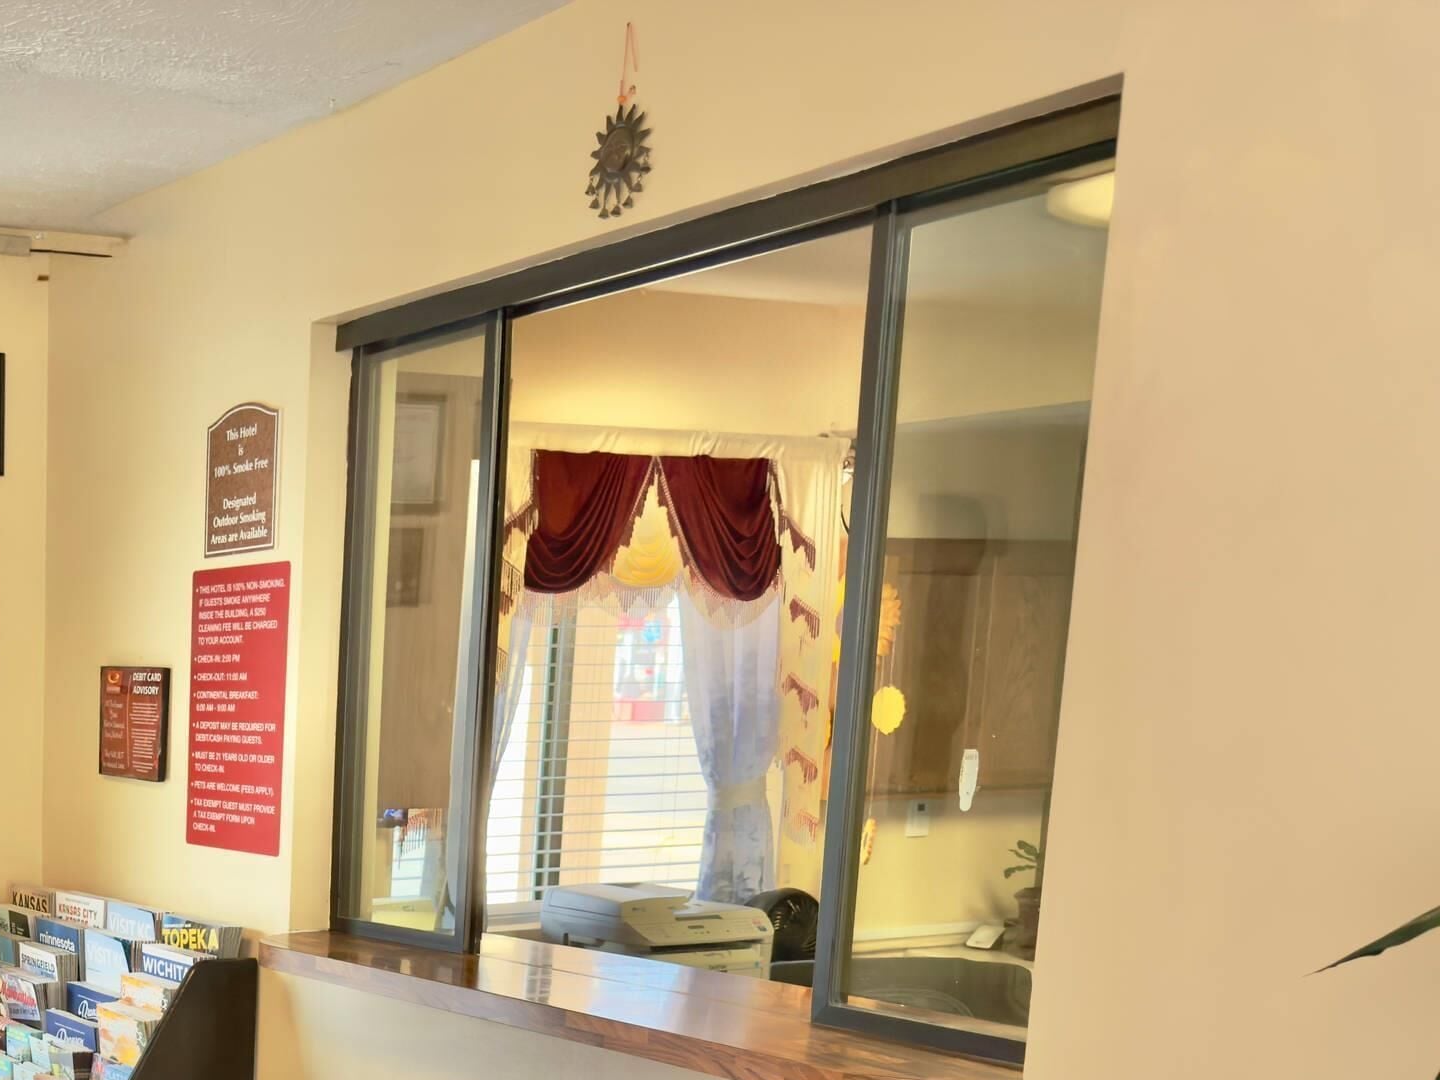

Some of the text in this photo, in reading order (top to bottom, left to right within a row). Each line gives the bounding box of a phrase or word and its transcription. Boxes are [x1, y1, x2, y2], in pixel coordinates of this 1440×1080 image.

[226, 423, 258, 441] This Hotel
[238, 444, 244, 456] is
[214, 457, 269, 479] 100% Smoke Free
[223, 492, 256, 511] Designated
[213, 509, 266, 529] Outdoor Smoking
[211, 525, 268, 545] Areas are Available
[200, 585, 210, 594] THIS
[210, 584, 226, 593] HOTEL
[223, 595, 241, 606] SMOKE
[223, 622, 232, 632] FEE
[233, 621, 244, 631] WILL
[245, 621, 252, 630] BE
[253, 620, 278, 630] CHARGED
[198, 637, 204, 645] TO
[205, 636, 219, 645] YOUR
[232, 654, 240, 662] PM
[132, 672, 162, 682] DEBIT CARD
[132, 685, 159, 696] ADVISORY
[232, 723, 239, 731] BE
[265, 723, 276, 732] FOR
[222, 753, 237, 762] YEARS
[238, 754, 249, 762] OLD
[250, 754, 257, 763] OR
[258, 755, 275, 764] OLDER
[12, 891, 48, 914] KANSAS
[58, 903, 98, 921] KANSAS CITY
[40, 931, 76, 952] minnesota
[162, 927, 219, 951] TOPEKA
